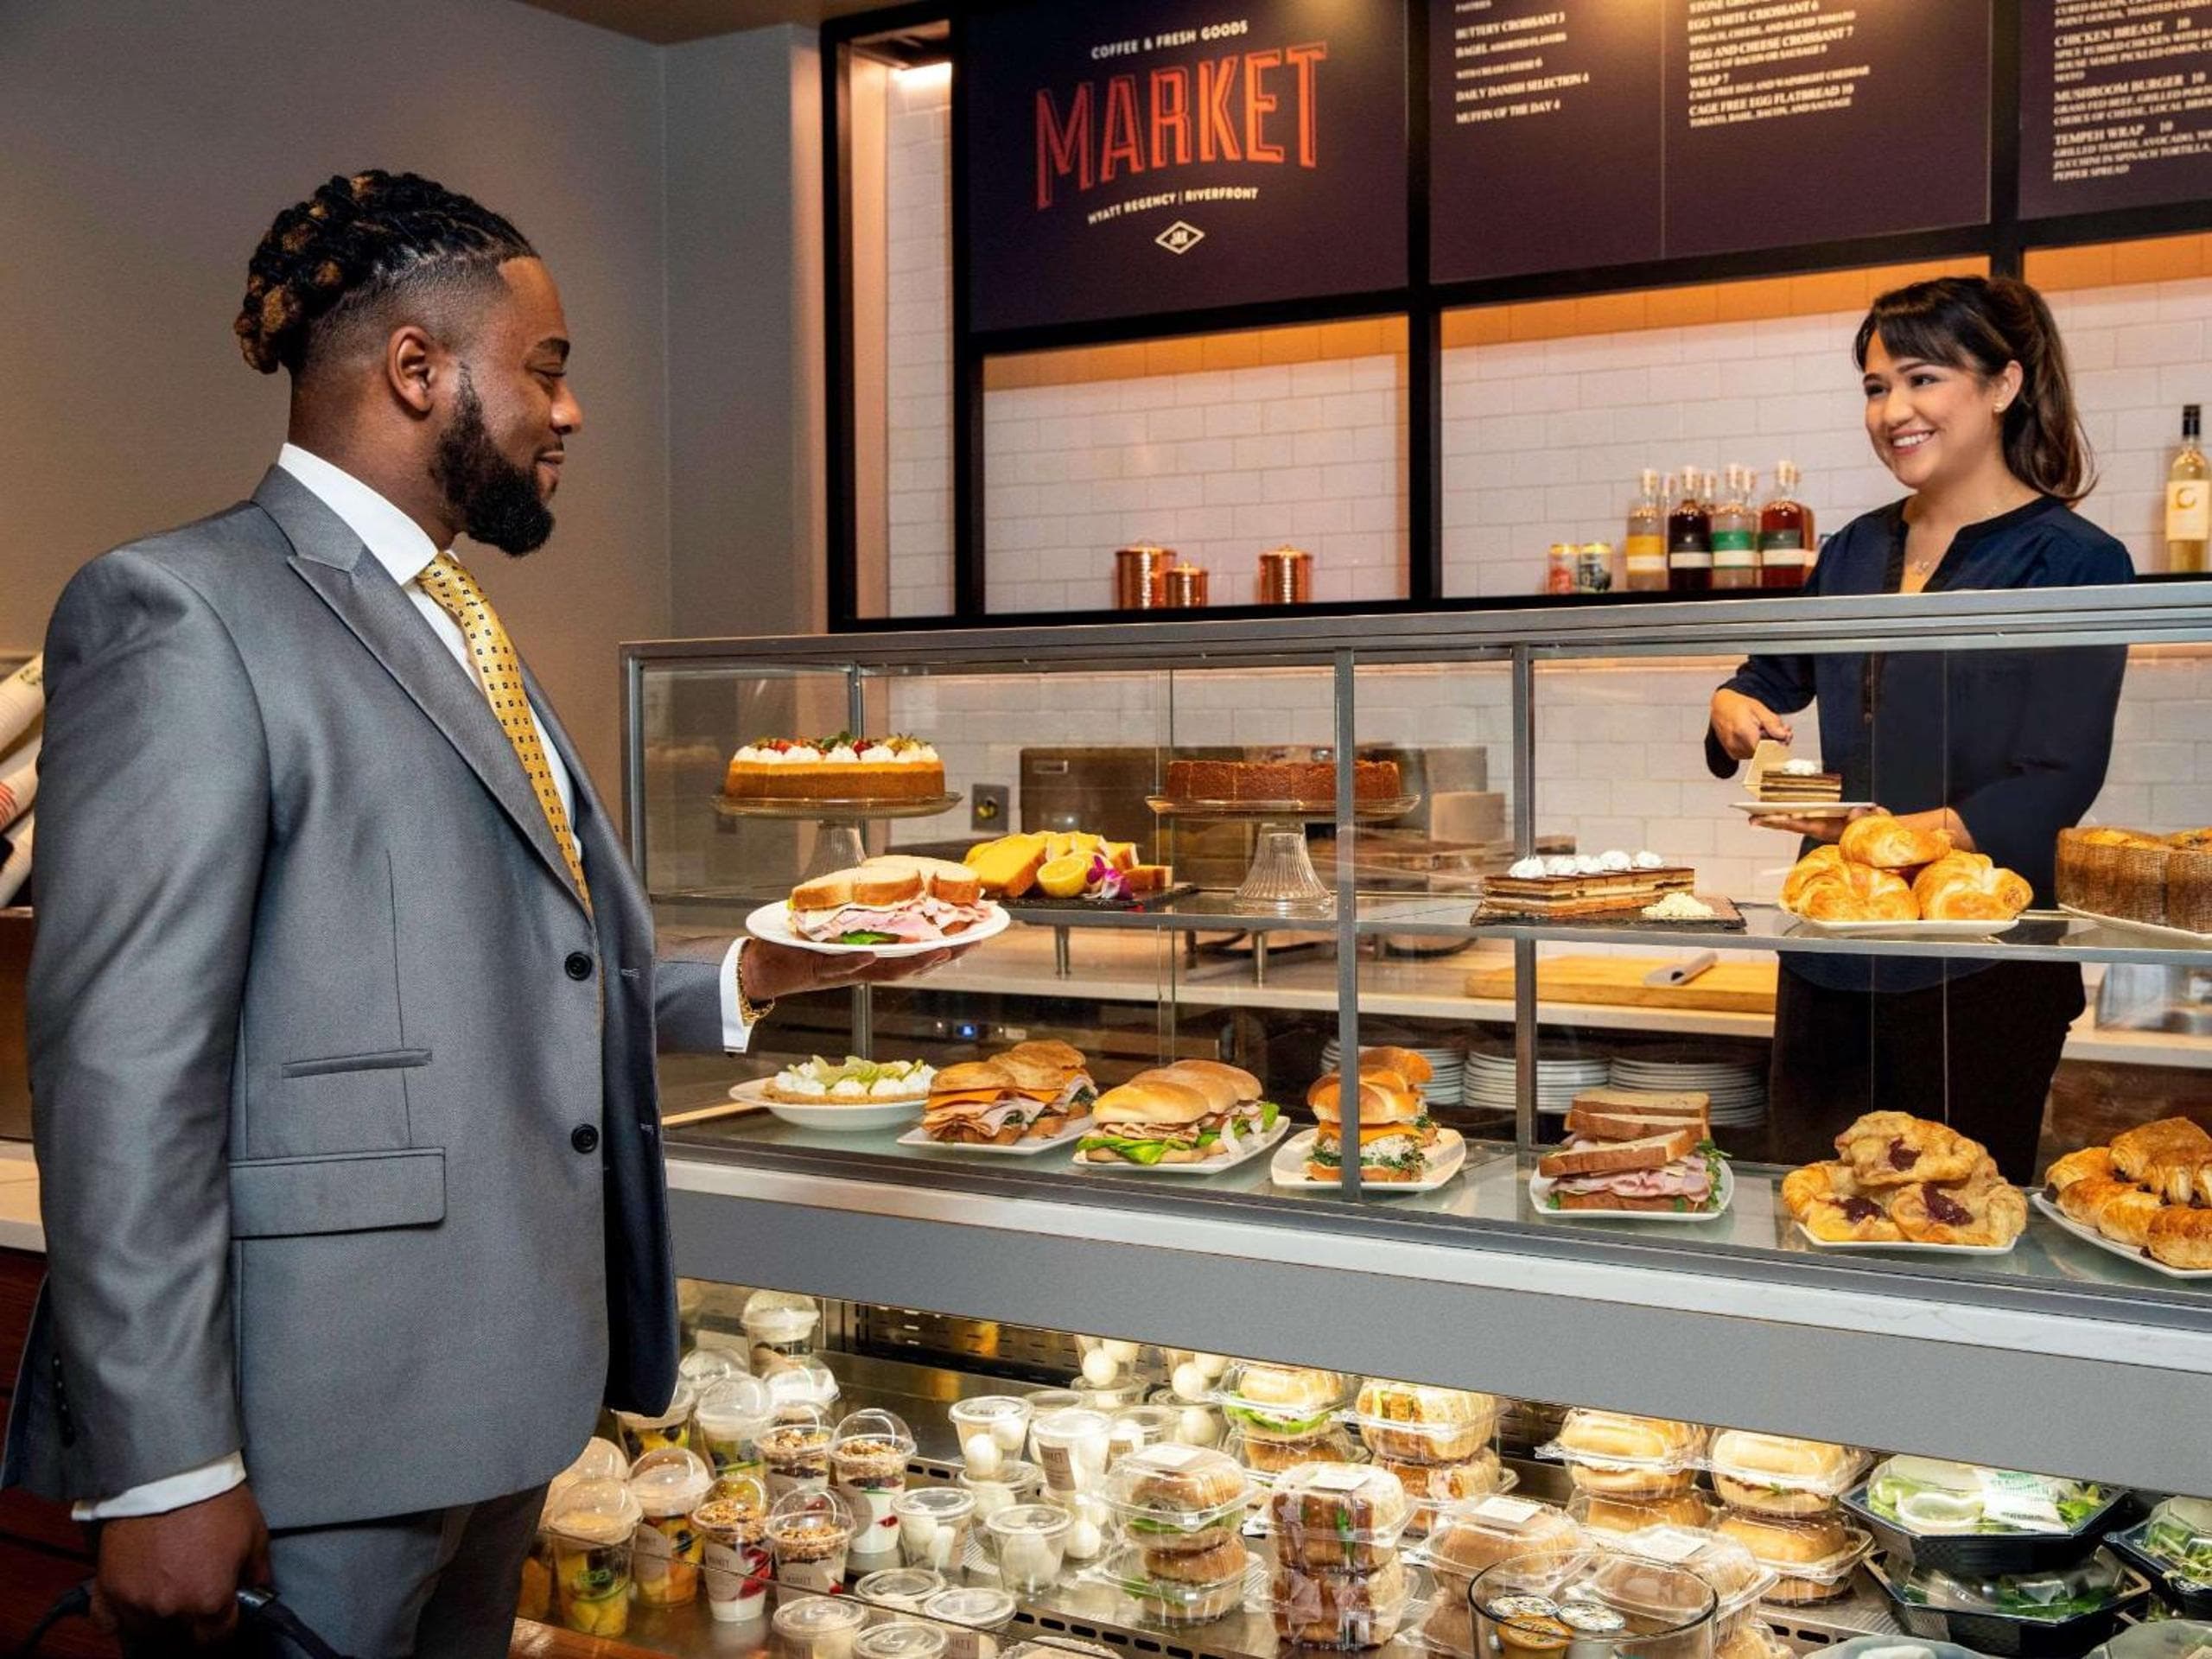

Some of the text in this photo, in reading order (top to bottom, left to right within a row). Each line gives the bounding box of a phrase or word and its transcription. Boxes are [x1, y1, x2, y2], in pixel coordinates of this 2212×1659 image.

[1091, 20, 1248, 60] COFFEE & FRESH GOODS
[2054, 29, 2111, 48] CHICKEN
[2113, 21, 2164, 38] BREAST
[2054, 81, 2128, 102] MUSHROOM
[2131, 74, 2183, 92] BURGER
[1035, 41, 1327, 211] MARKET
[1088, 187, 1259, 225] HYATT REGENCY RIVERFRONT
